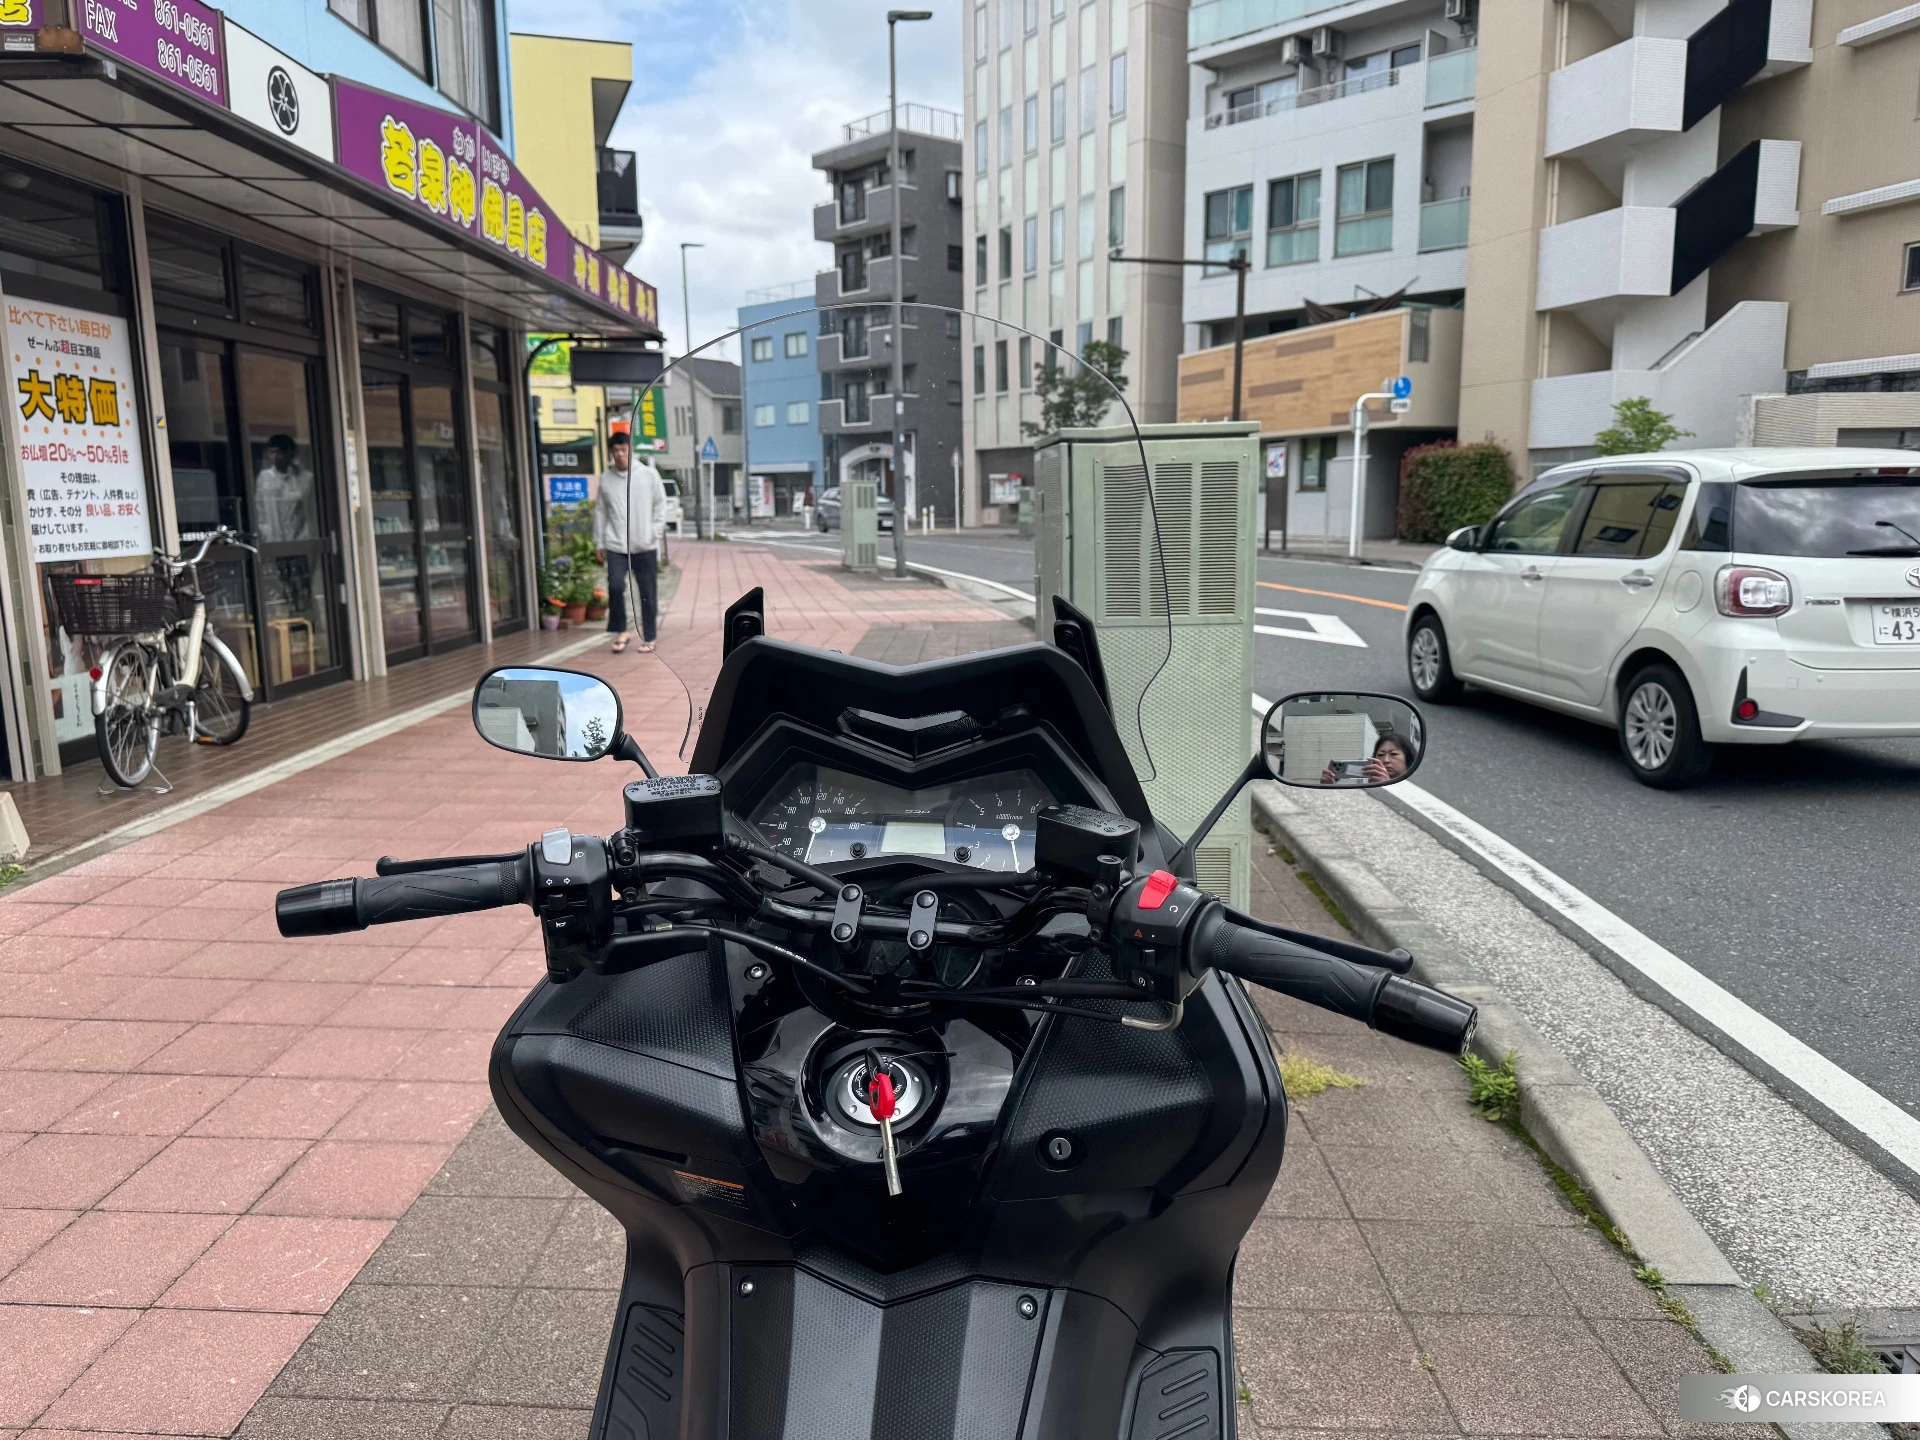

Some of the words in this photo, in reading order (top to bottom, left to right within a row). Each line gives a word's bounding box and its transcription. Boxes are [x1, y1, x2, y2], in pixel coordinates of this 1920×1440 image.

[85, 0, 119, 43] FAX
[154, 0, 215, 54] 861-0561
[157, 38, 219, 95] 861-0561
[8, 305, 112, 340] 比べて下さい毎日が
[28, 337, 102, 359] ぜーんぶ超目玉商品
[17, 369, 120, 427] 大特価
[1891, 607, 1920, 618] 横浜5
[979, 807, 985, 816] 5
